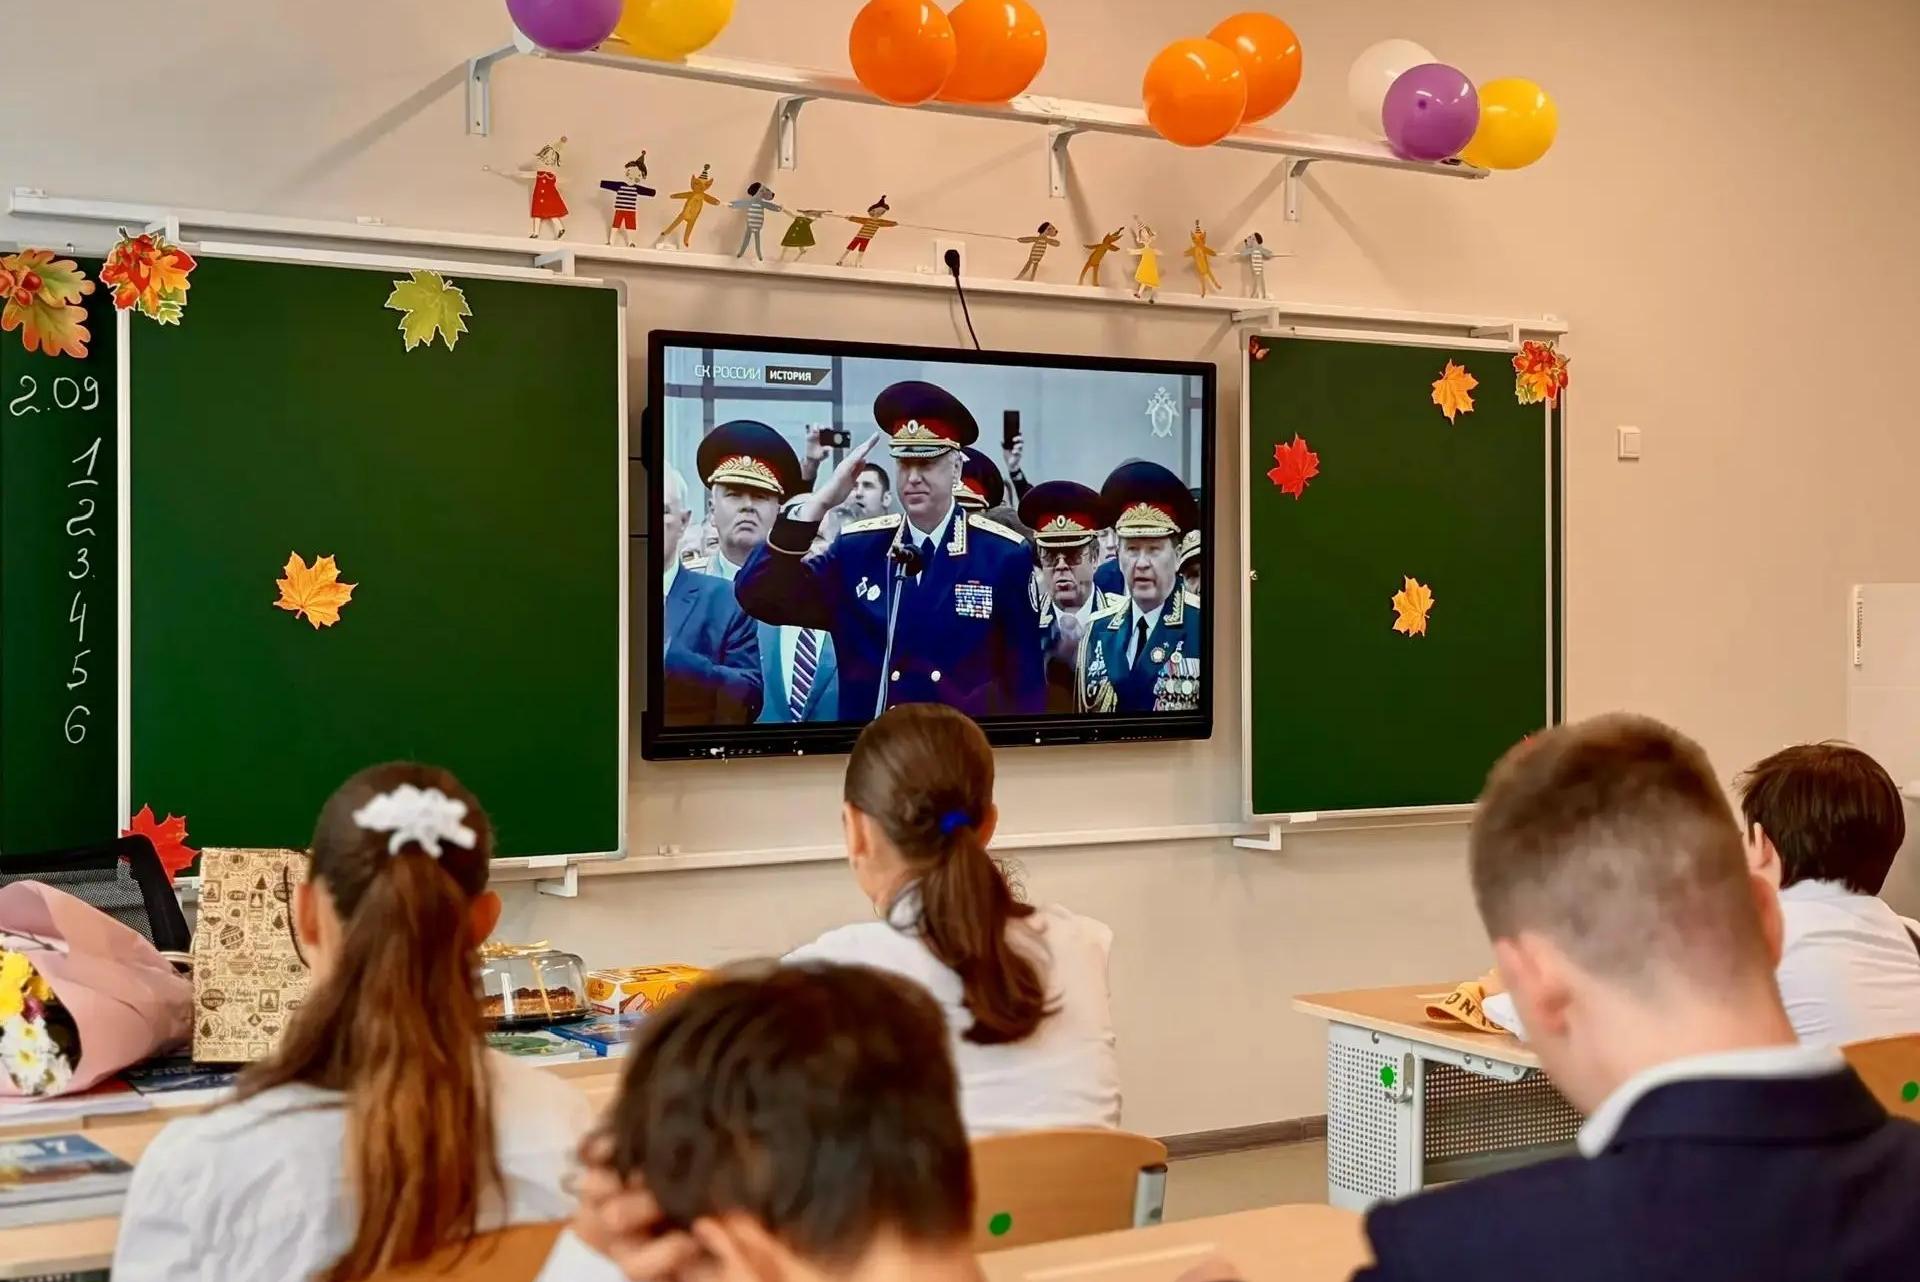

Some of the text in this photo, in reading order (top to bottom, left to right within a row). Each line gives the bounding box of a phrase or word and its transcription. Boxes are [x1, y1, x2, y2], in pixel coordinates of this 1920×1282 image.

[694, 364, 761, 380] СК РОССИИ
[769, 370, 812, 382] ИСТОРИЯ
[9, 375, 100, 416] 2.09
[72, 437, 102, 476] 1
[66, 498, 96, 536] 2
[69, 590, 87, 642] 4
[66, 649, 92, 690] 5
[65, 705, 91, 744] 6
